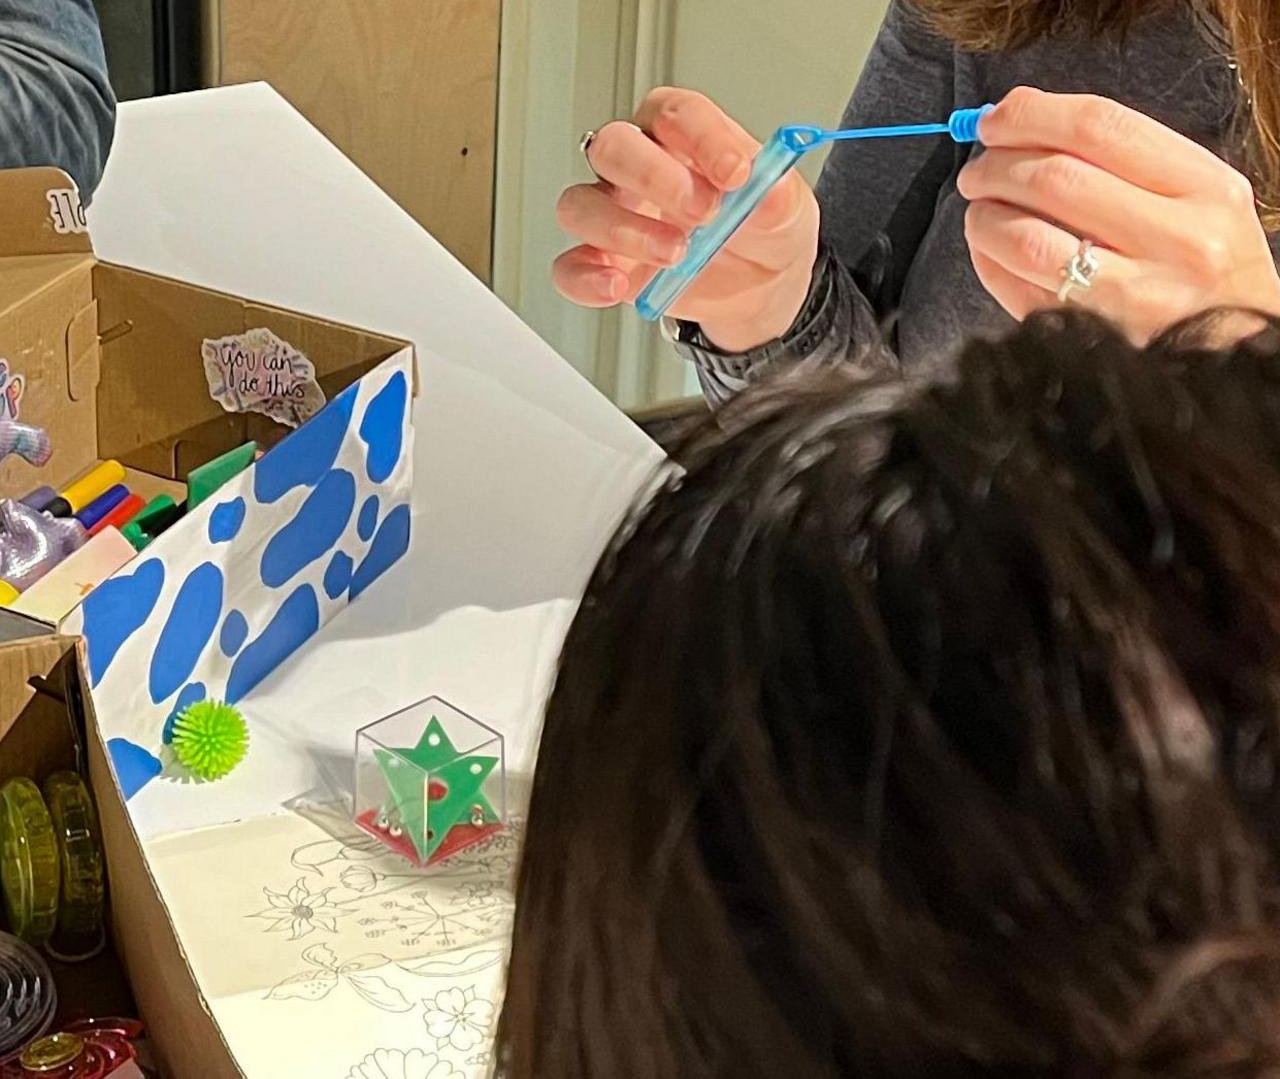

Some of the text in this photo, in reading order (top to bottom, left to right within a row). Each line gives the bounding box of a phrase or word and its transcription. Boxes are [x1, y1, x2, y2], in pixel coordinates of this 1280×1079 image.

[221, 349, 293, 388] you can
[239, 371, 305, 398] do this
